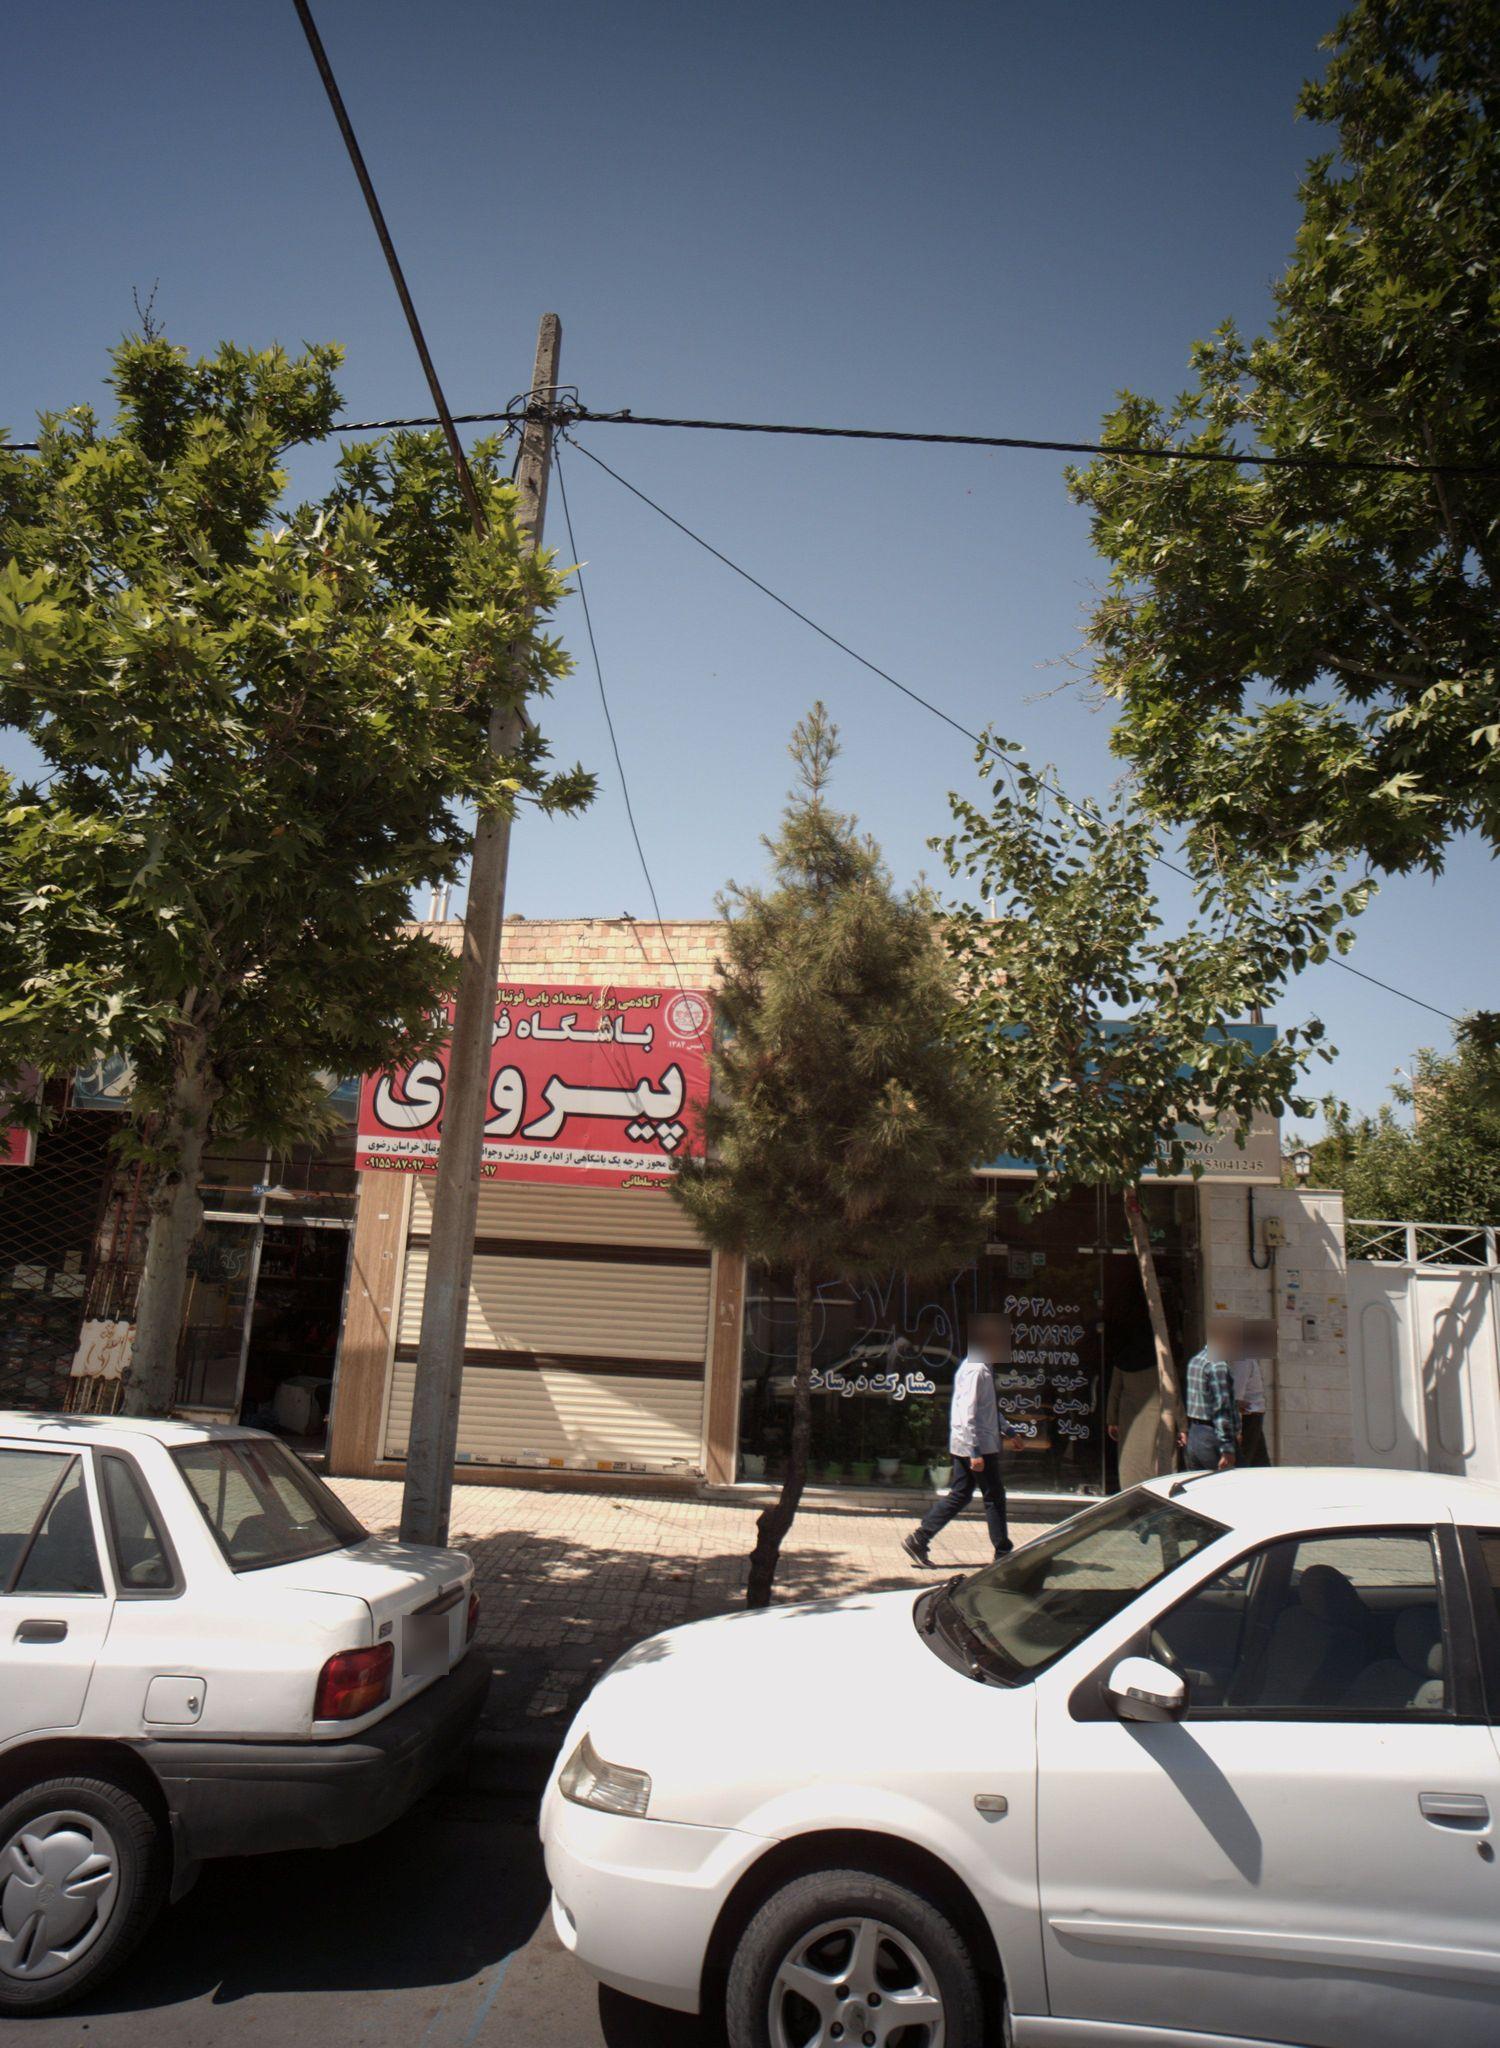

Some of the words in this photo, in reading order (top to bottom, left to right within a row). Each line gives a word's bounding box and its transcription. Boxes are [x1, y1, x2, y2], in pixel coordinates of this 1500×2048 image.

[526, 990, 549, 1007] یابی
[551, 990, 593, 1006] استعداد
[618, 993, 661, 1011] آکادمی
[516, 1010, 654, 1052] باشگاه
[374, 1056, 685, 1152] پیروی
[368, 1140, 390, 1152] رضوی
[392, 1141, 419, 1154] خراسان
[422, 1141, 440, 1155] وتبال
[504, 1148, 528, 1161] ورزش
[530, 1150, 541, 1161] کل
[543, 1151, 563, 1163] اداره
[565, 1153, 572, 1164] از
[574, 1153, 606, 1167] باشگاهی
[609, 1155, 620, 1167] یک
[623, 1157, 644, 1168] درجه
[647, 1160, 666, 1169] مجوز
[622, 1175, 653, 1188] سلطانی
[1004, 1295, 1080, 1317] ۶۶۳۸۰۰۰
[1010, 1323, 1085, 1345] ۶۱۷۹۹۶
[791, 1368, 845, 1391] ساخ
[870, 1371, 936, 1400] مشارکت
[1000, 1369, 1046, 1388] فروش
[1052, 1370, 1088, 1392] خرید
[999, 1394, 1042, 1414] اجاره
[1053, 1398, 1090, 1415] رهن
[1006, 1419, 1038, 1437] زمی
[1057, 1419, 1090, 1441] ویلا
